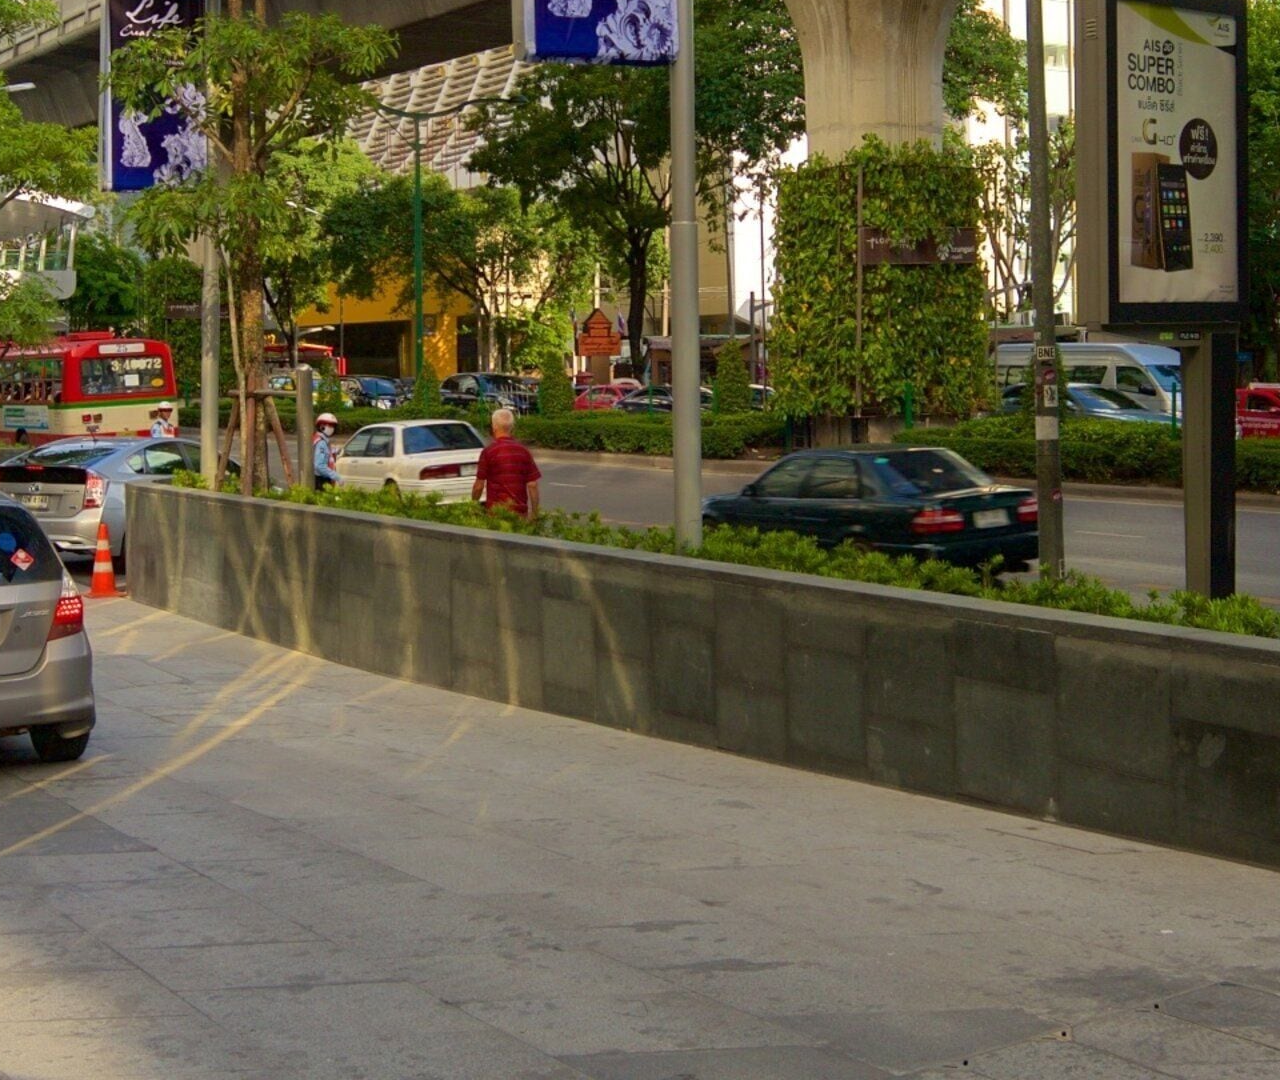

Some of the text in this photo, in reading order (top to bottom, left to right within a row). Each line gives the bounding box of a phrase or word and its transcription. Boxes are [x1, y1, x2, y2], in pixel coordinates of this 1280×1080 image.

[1143, 39, 1161, 52] AIS
[1127, 53, 1174, 76] SUPER
[1128, 73, 1175, 94] COMBO
[1038, 347, 1055, 358] BNE
